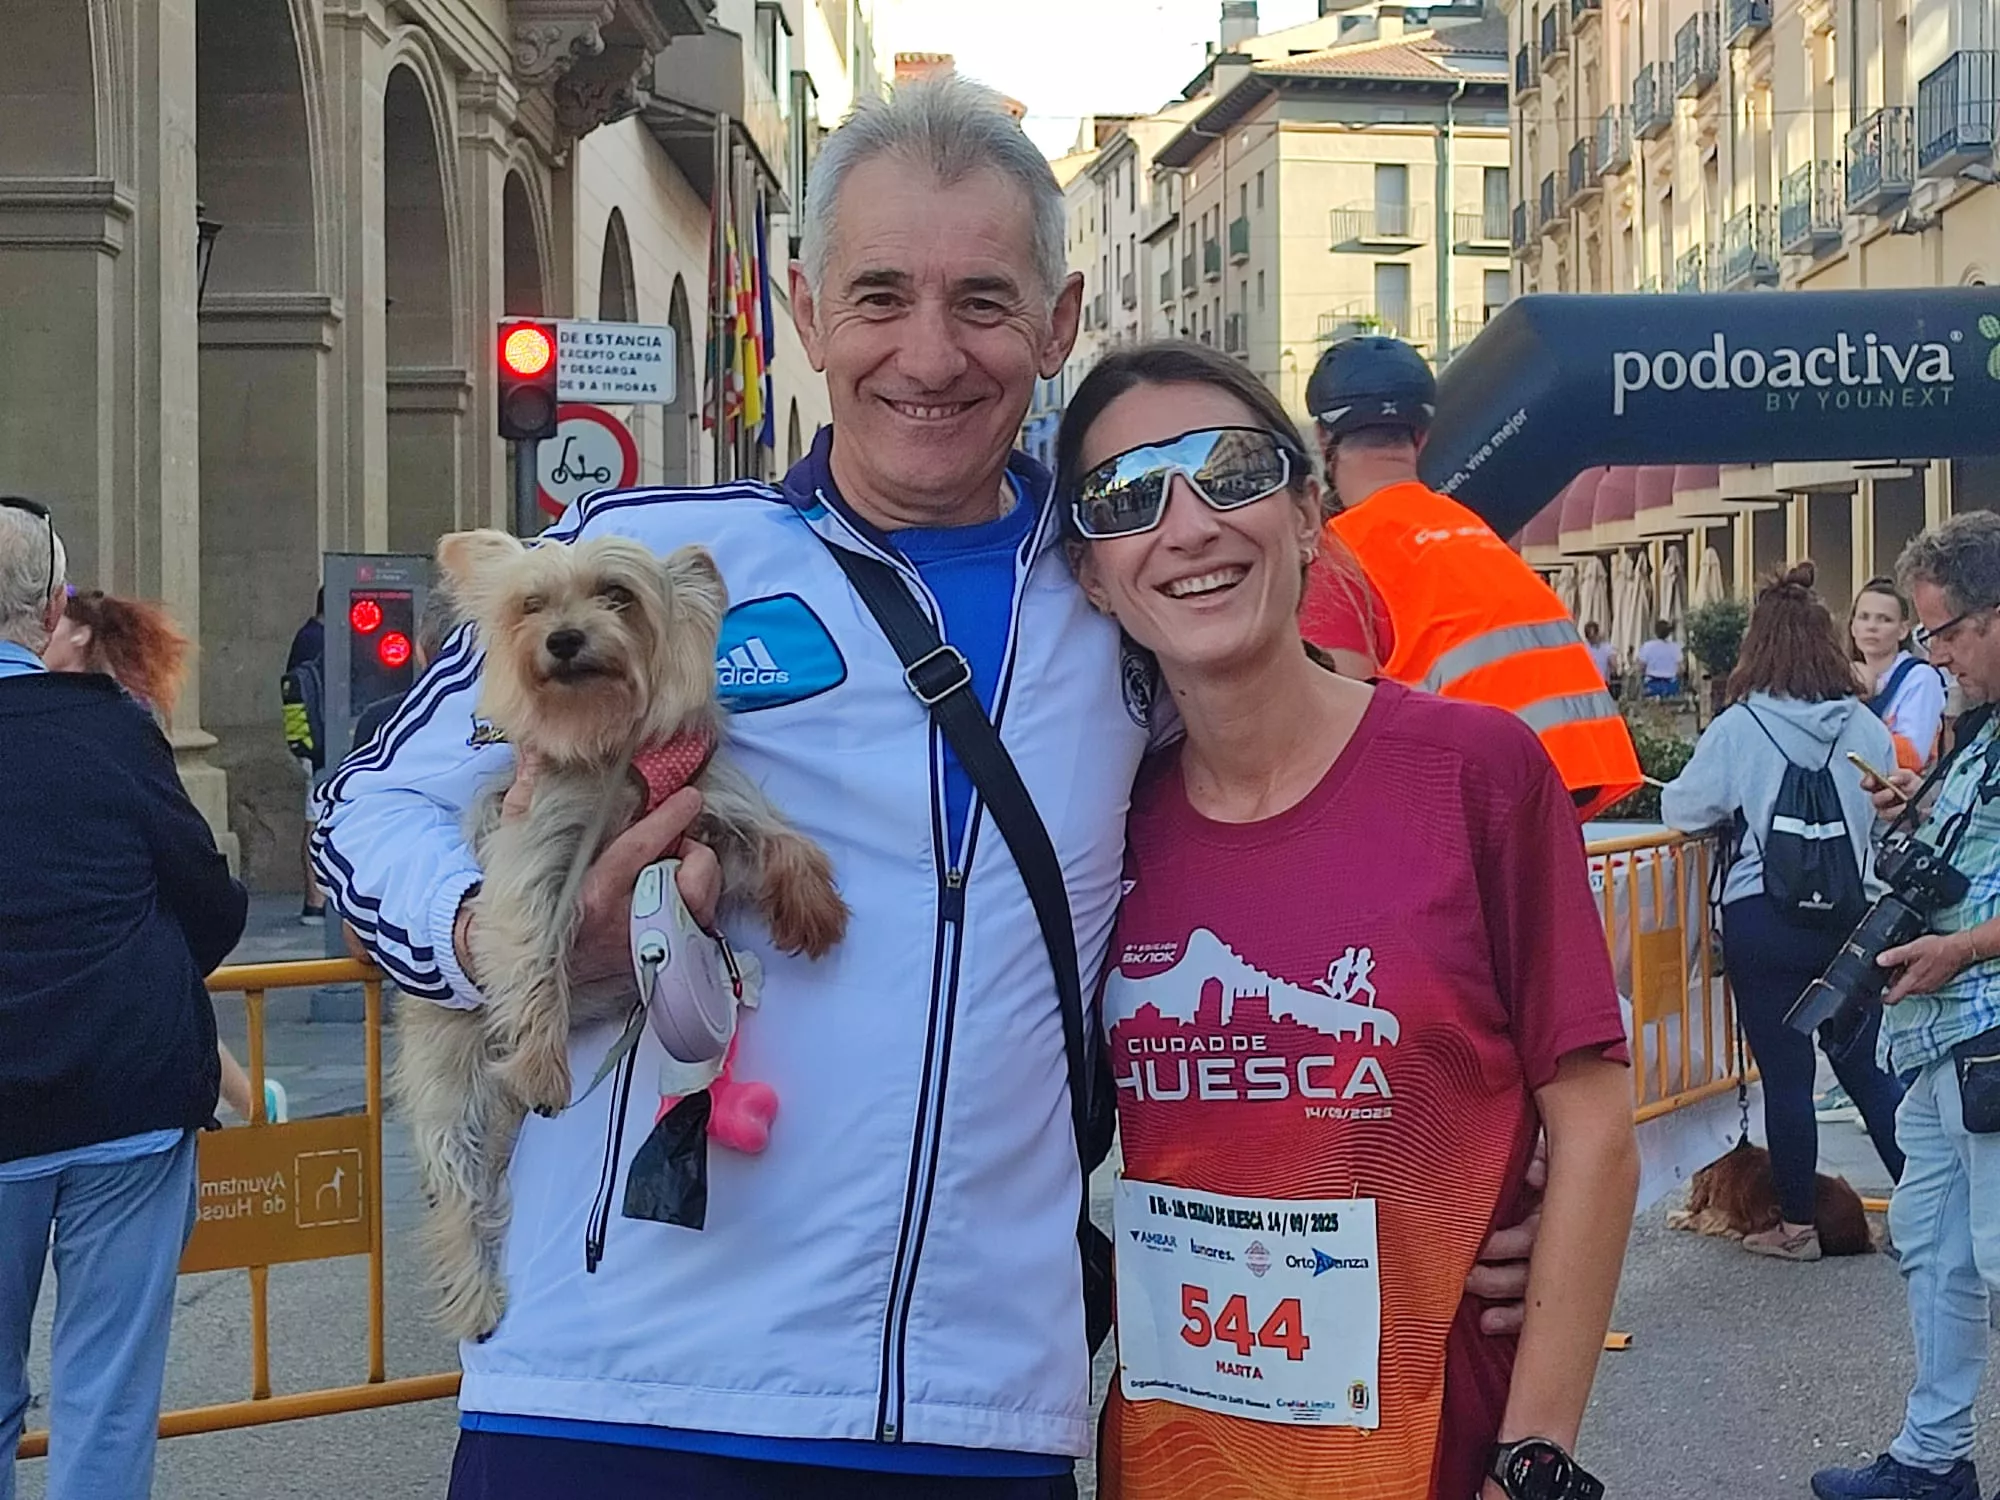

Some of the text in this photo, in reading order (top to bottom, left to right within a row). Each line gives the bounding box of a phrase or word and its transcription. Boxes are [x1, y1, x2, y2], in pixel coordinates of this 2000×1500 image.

[560, 332, 662, 347] DE ESTANCIA
[559, 348, 661, 362] EXCEPTO CARGA
[570, 364, 637, 376] DESCARGA
[590, 381, 598, 390] A
[615, 382, 657, 393] HORAS
[1766, 386, 1954, 412] BY YOUNEXT
[1466, 444, 1493, 471] vive
[1491, 407, 1528, 448] mejor
[719, 667, 790, 686] didas
[1127, 1036, 1267, 1053] CIUDAD DE
[1113, 1055, 1393, 1101] HUESCA
[1227, 1208, 1264, 1231] HUESCA
[1180, 1283, 1310, 1361] 544
[1216, 1360, 1264, 1380] MARTA
